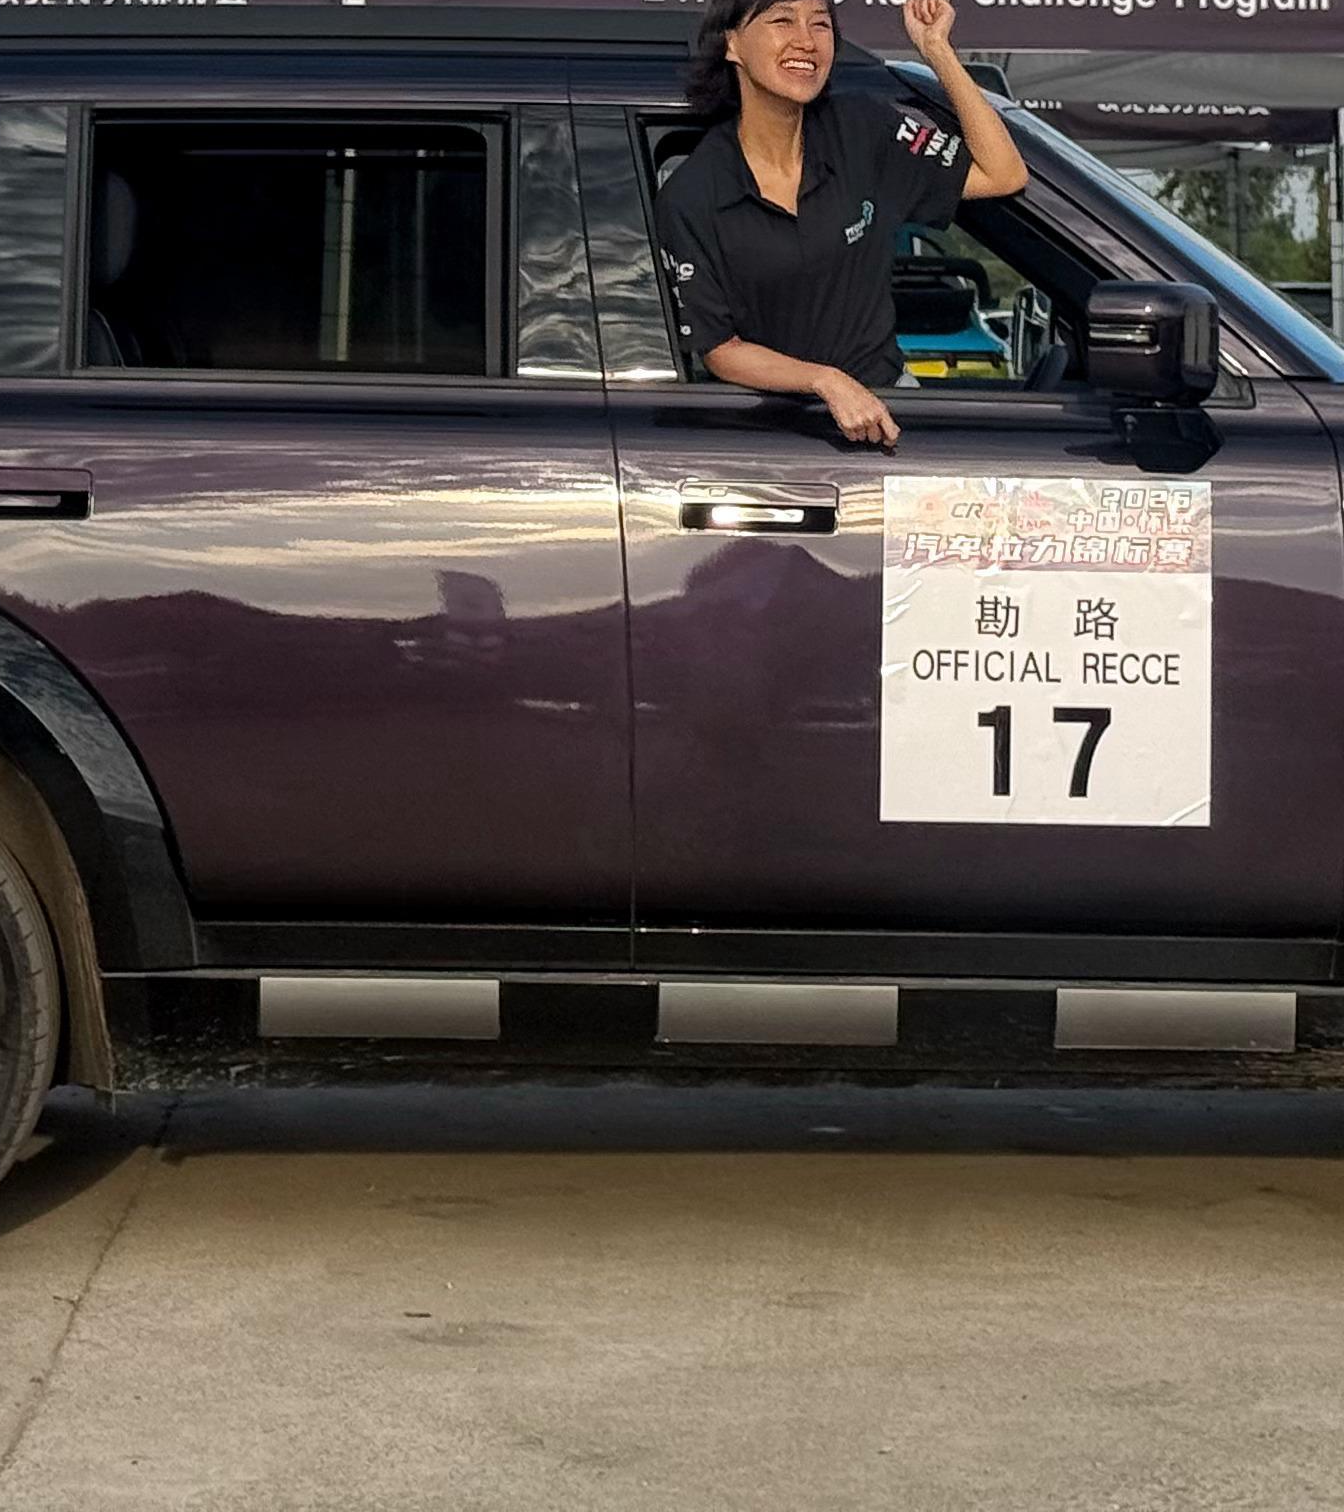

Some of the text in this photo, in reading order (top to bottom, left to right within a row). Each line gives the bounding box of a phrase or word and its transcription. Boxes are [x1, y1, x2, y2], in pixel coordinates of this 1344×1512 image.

[912, 649, 1180, 686] OFFICIAL RECCE
[978, 705, 1112, 798] 17
